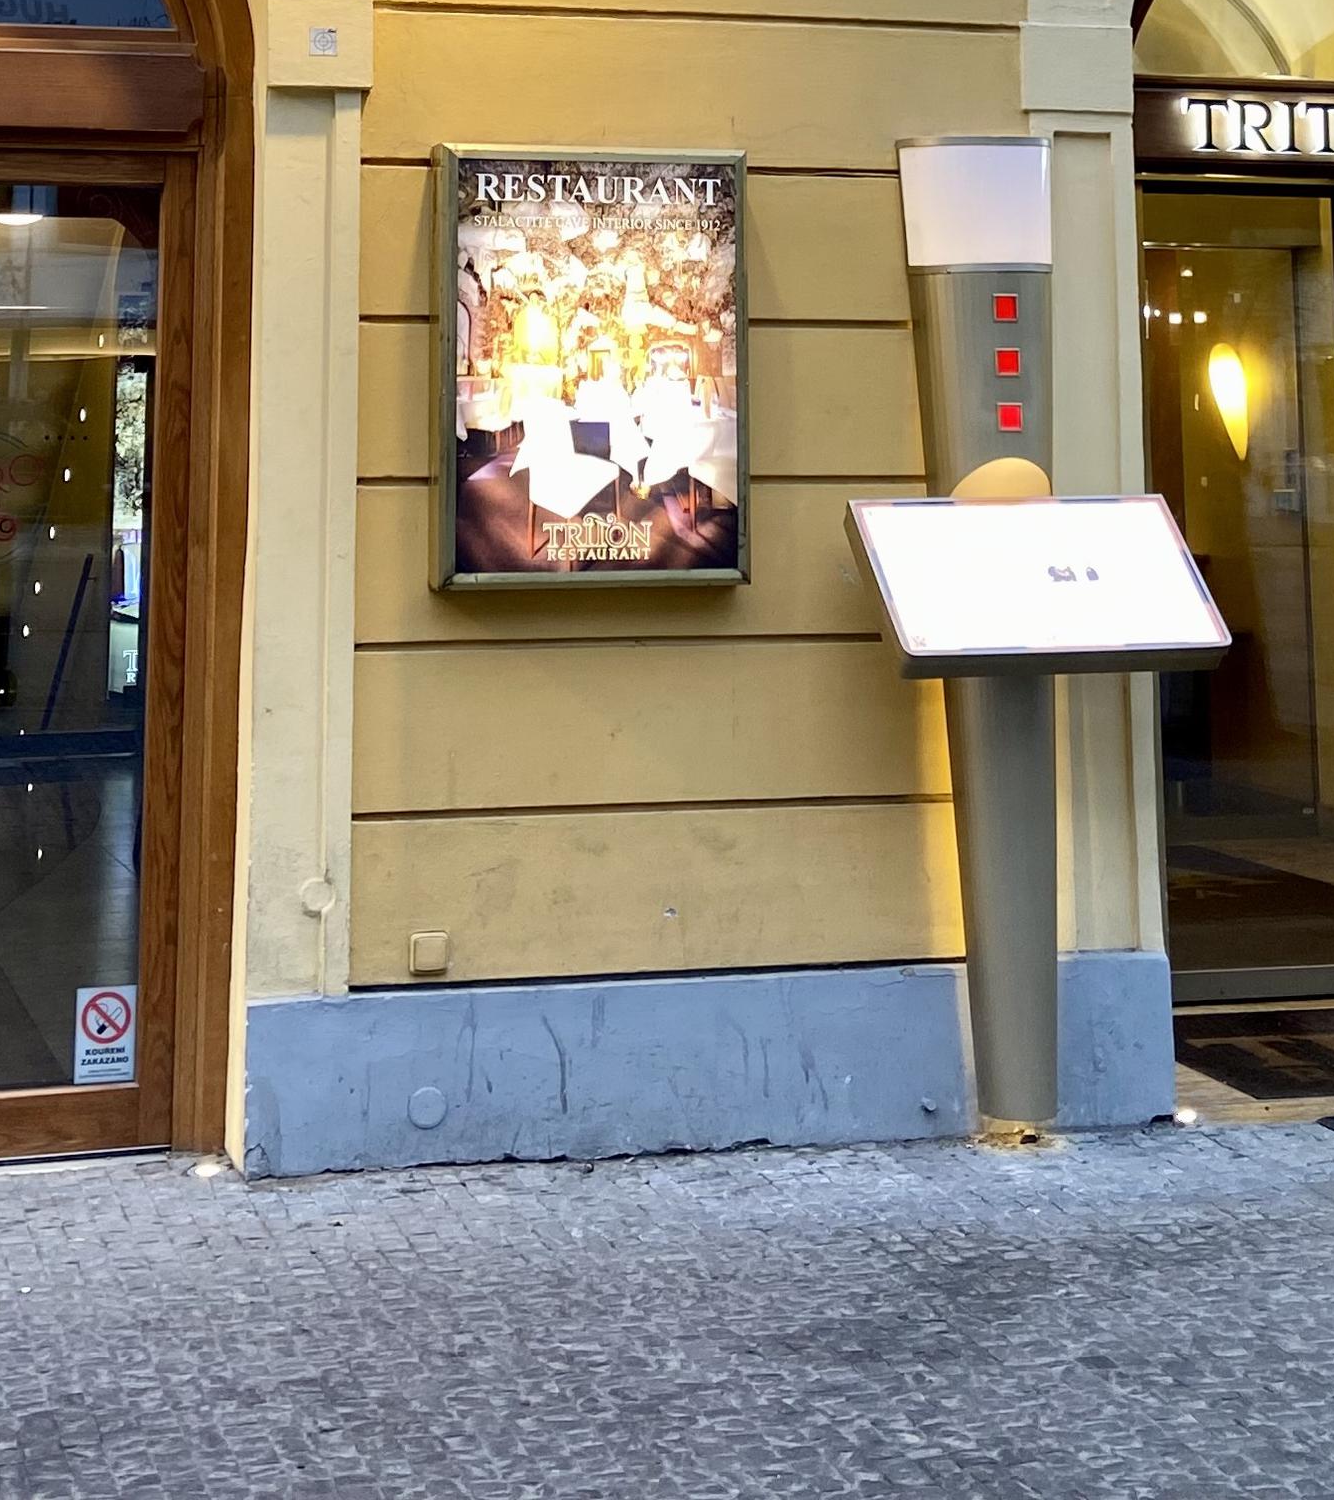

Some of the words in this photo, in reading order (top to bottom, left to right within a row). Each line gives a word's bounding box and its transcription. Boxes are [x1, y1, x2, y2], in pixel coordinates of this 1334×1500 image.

[475, 173, 722, 206] RESTAURANT
[474, 215, 553, 229] STALACTITE
[554, 217, 589, 230] CAVE
[593, 217, 653, 231] INTERIOR
[655, 219, 692, 231] SINCE
[696, 219, 721, 232] 1912
[542, 512, 653, 548] TRITON
[546, 547, 652, 561] RESTAURANT
